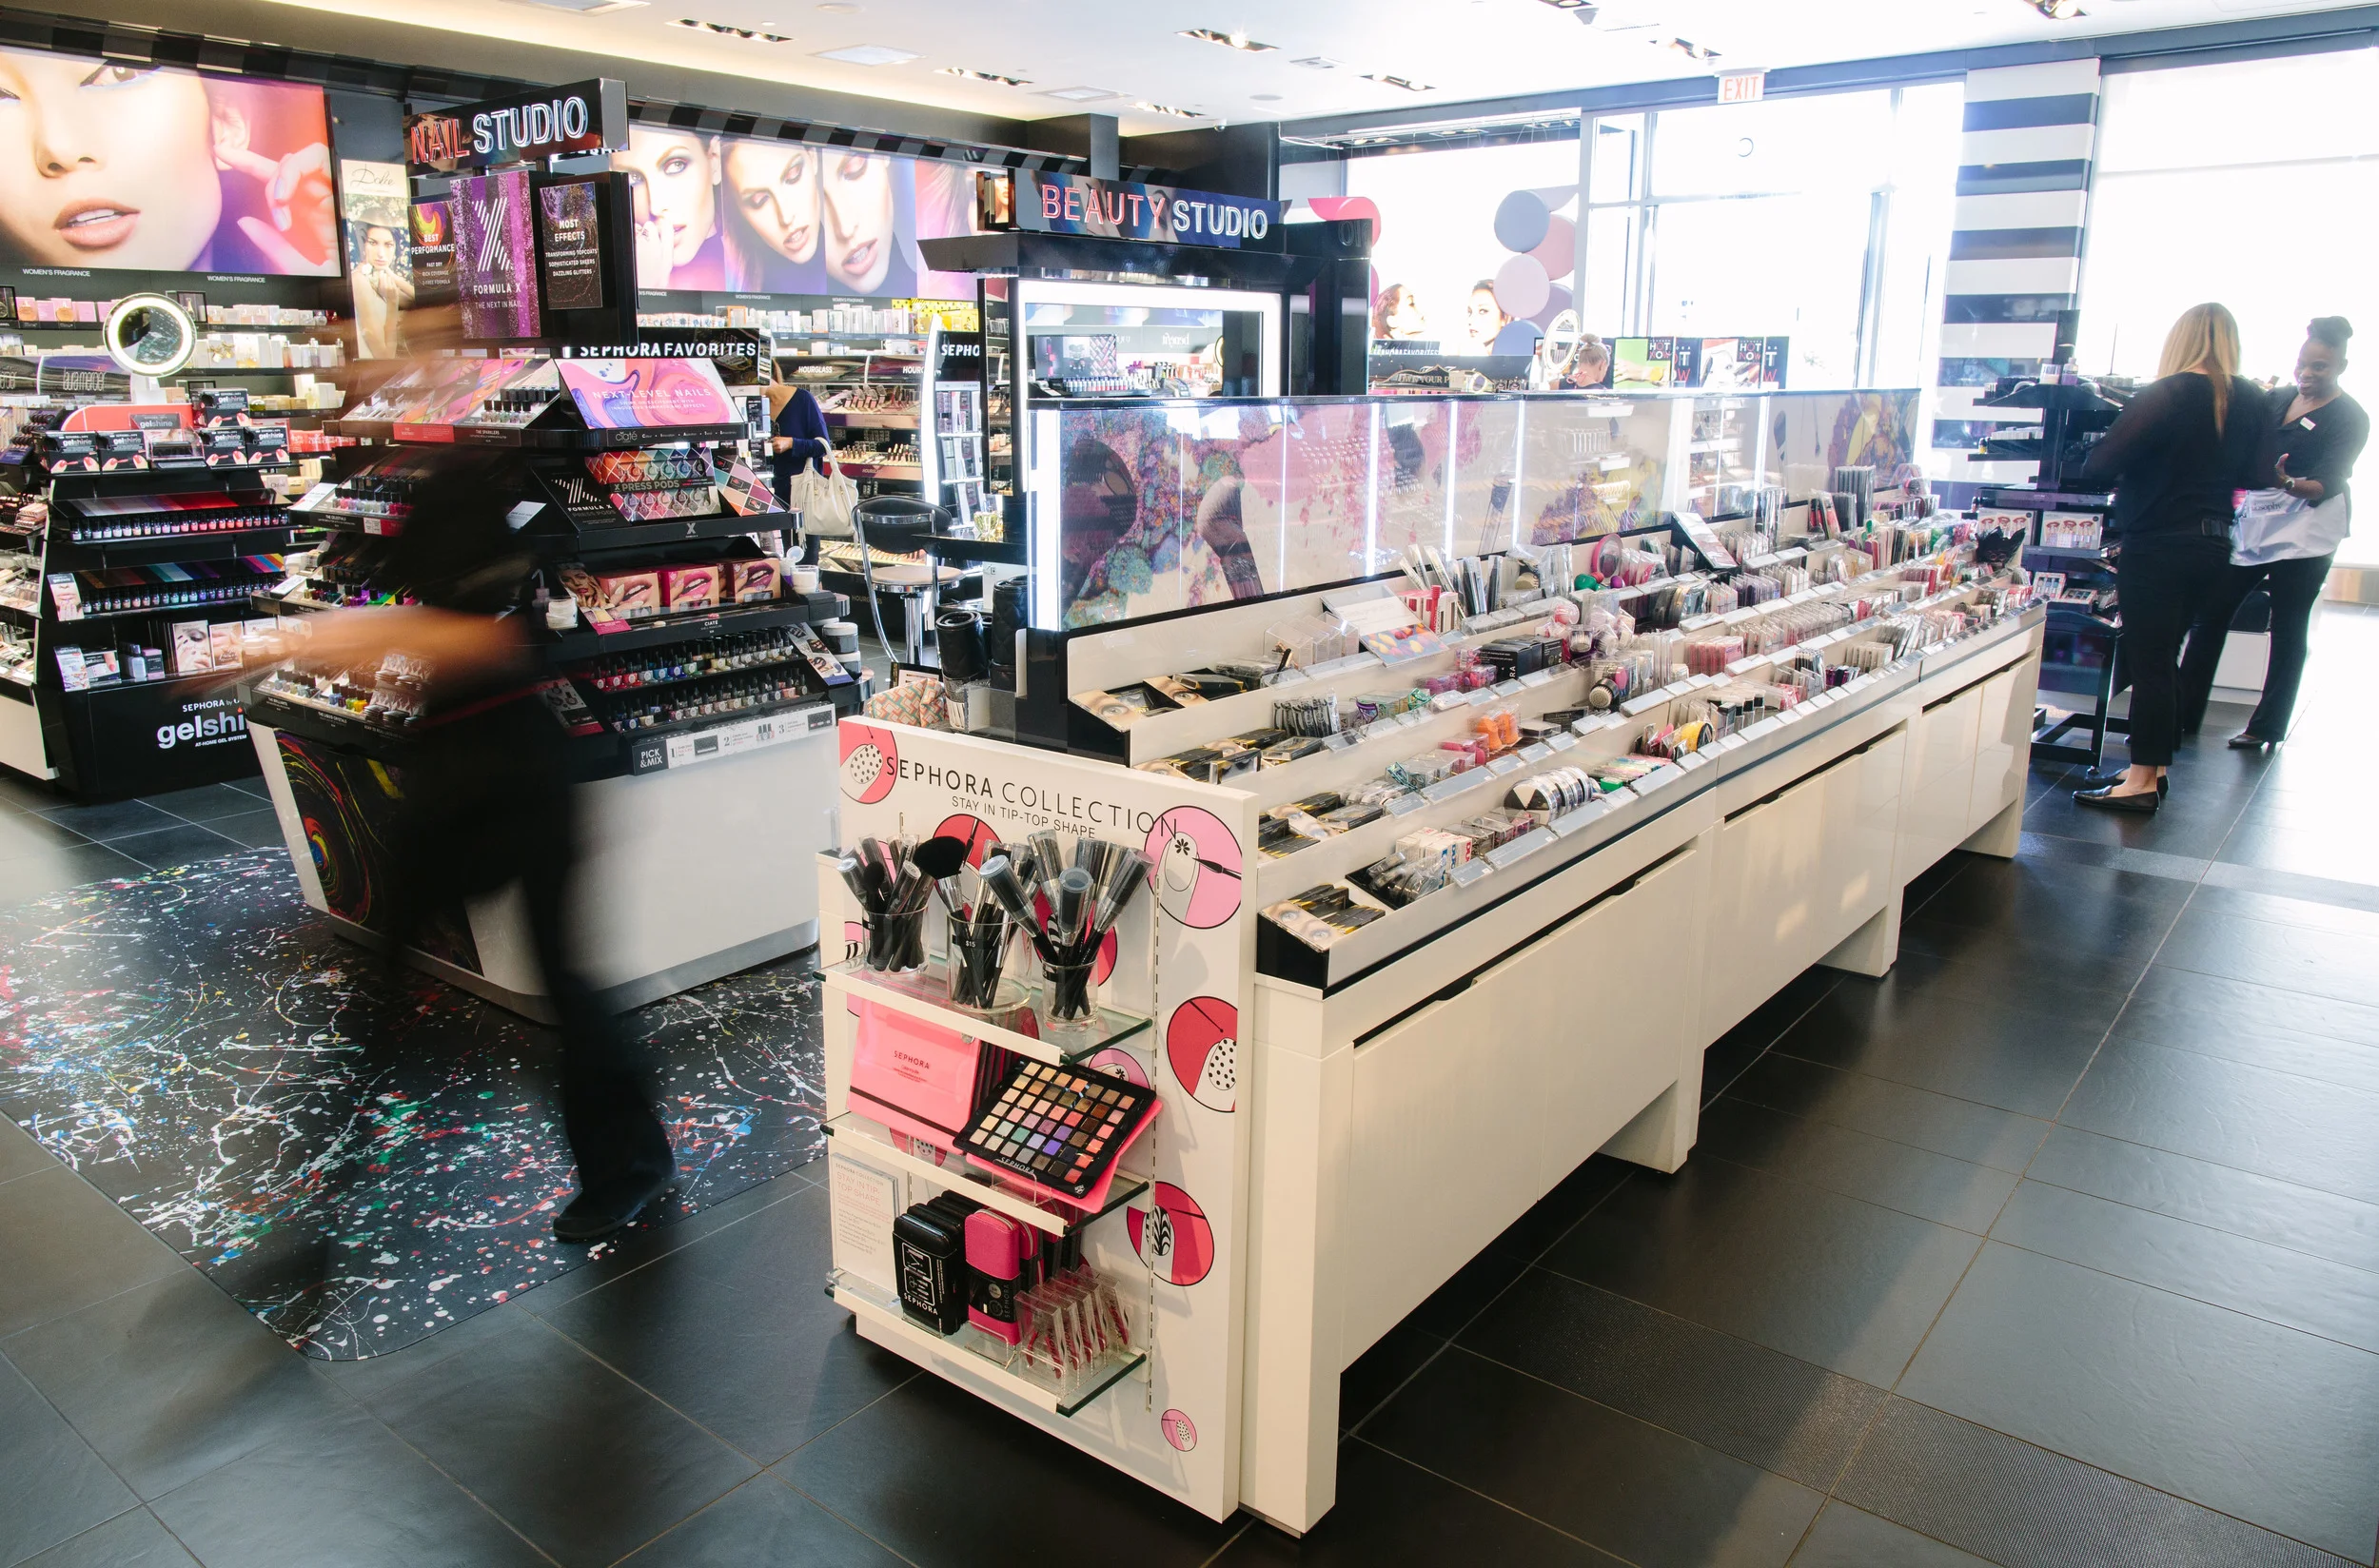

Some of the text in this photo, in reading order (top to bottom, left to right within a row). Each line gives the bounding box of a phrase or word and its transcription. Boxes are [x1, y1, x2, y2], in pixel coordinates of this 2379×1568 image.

[1723, 76, 1759, 101] EXIT
[410, 96, 588, 165] NAIL STUDIO
[1042, 185, 1268, 239] BEAUTY STUDIO
[559, 219, 579, 229] MOST
[423, 232, 439, 243] BEST
[554, 230, 585, 242] EFFECTS
[411, 243, 455, 255] PERFORMANCE
[576, 248, 598, 257] TOPCOATS
[473, 283, 521, 295] FORMULA X
[580, 342, 757, 358] SEPHORA FAVORITES
[1649, 342, 1671, 351] HOT
[1740, 343, 1761, 352] HOT
[1740, 352, 1761, 360] NOW
[798, 365, 833, 374] HOURGLASS
[593, 388, 711, 400] NEXT-LEVEL NAILS
[139, 420, 173, 429] gelshine
[62, 439, 92, 447] gelshine
[113, 437, 142, 445] gelshine
[622, 481, 654, 491] PRESS
[655, 480, 680, 489] PODS
[851, 594, 883, 605] HOURGSS
[182, 698, 225, 713] SEPHORA
[157, 708, 249, 749] gelshi
[778, 725, 785, 734] 3
[195, 739, 217, 747] AT-HOME
[228, 734, 247, 743] SYSTEM
[724, 736, 730, 747] 2
[641, 748, 660, 758] PICK
[671, 748, 676, 758] 1
[640, 756, 663, 768] &MIX
[887, 756, 1177, 840] SEPHORA COLLECTION
[952, 796, 1095, 839] STAY IN TIP-TOP SHAPE
[965, 940, 976, 948] $15
[894, 1050, 930, 1069] SEPHORA
[836, 1163, 855, 1174] SEPHORA
[1000, 1156, 1035, 1174] SEPHORA
[837, 1172, 855, 1184] STAY
[857, 1181, 865, 1189] IN
[837, 1182, 881, 1206] TOP SHAPE
[904, 1292, 938, 1315] SEPHORA
